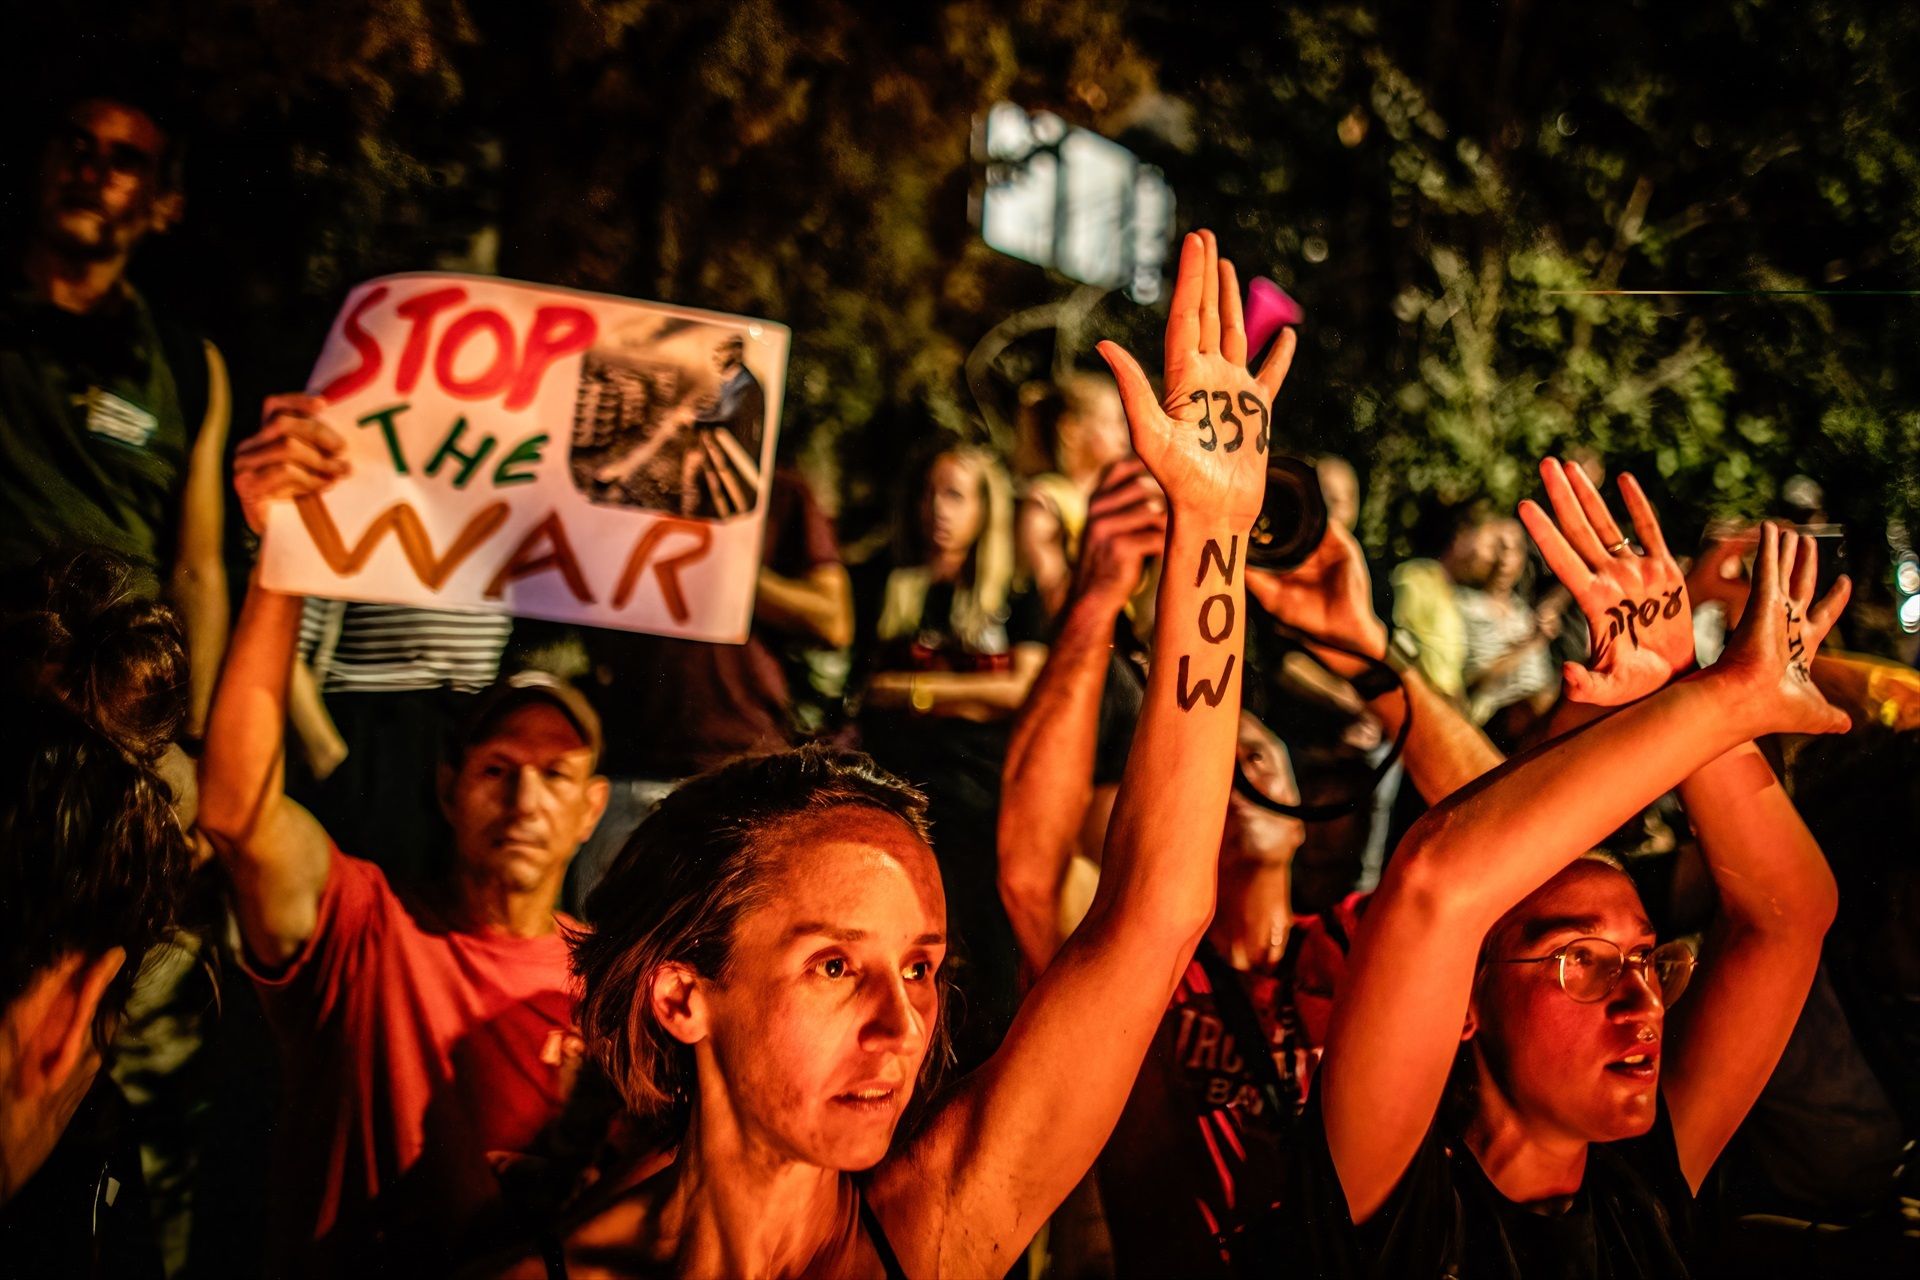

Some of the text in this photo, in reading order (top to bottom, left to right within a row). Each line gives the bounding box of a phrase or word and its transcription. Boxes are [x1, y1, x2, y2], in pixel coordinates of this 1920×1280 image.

[320, 286, 599, 412] STOP
[358, 404, 549, 489] THE
[293, 496, 712, 625] WAR
[1176, 534, 1237, 713] NOW
[1604, 585, 1683, 651] עסקה
